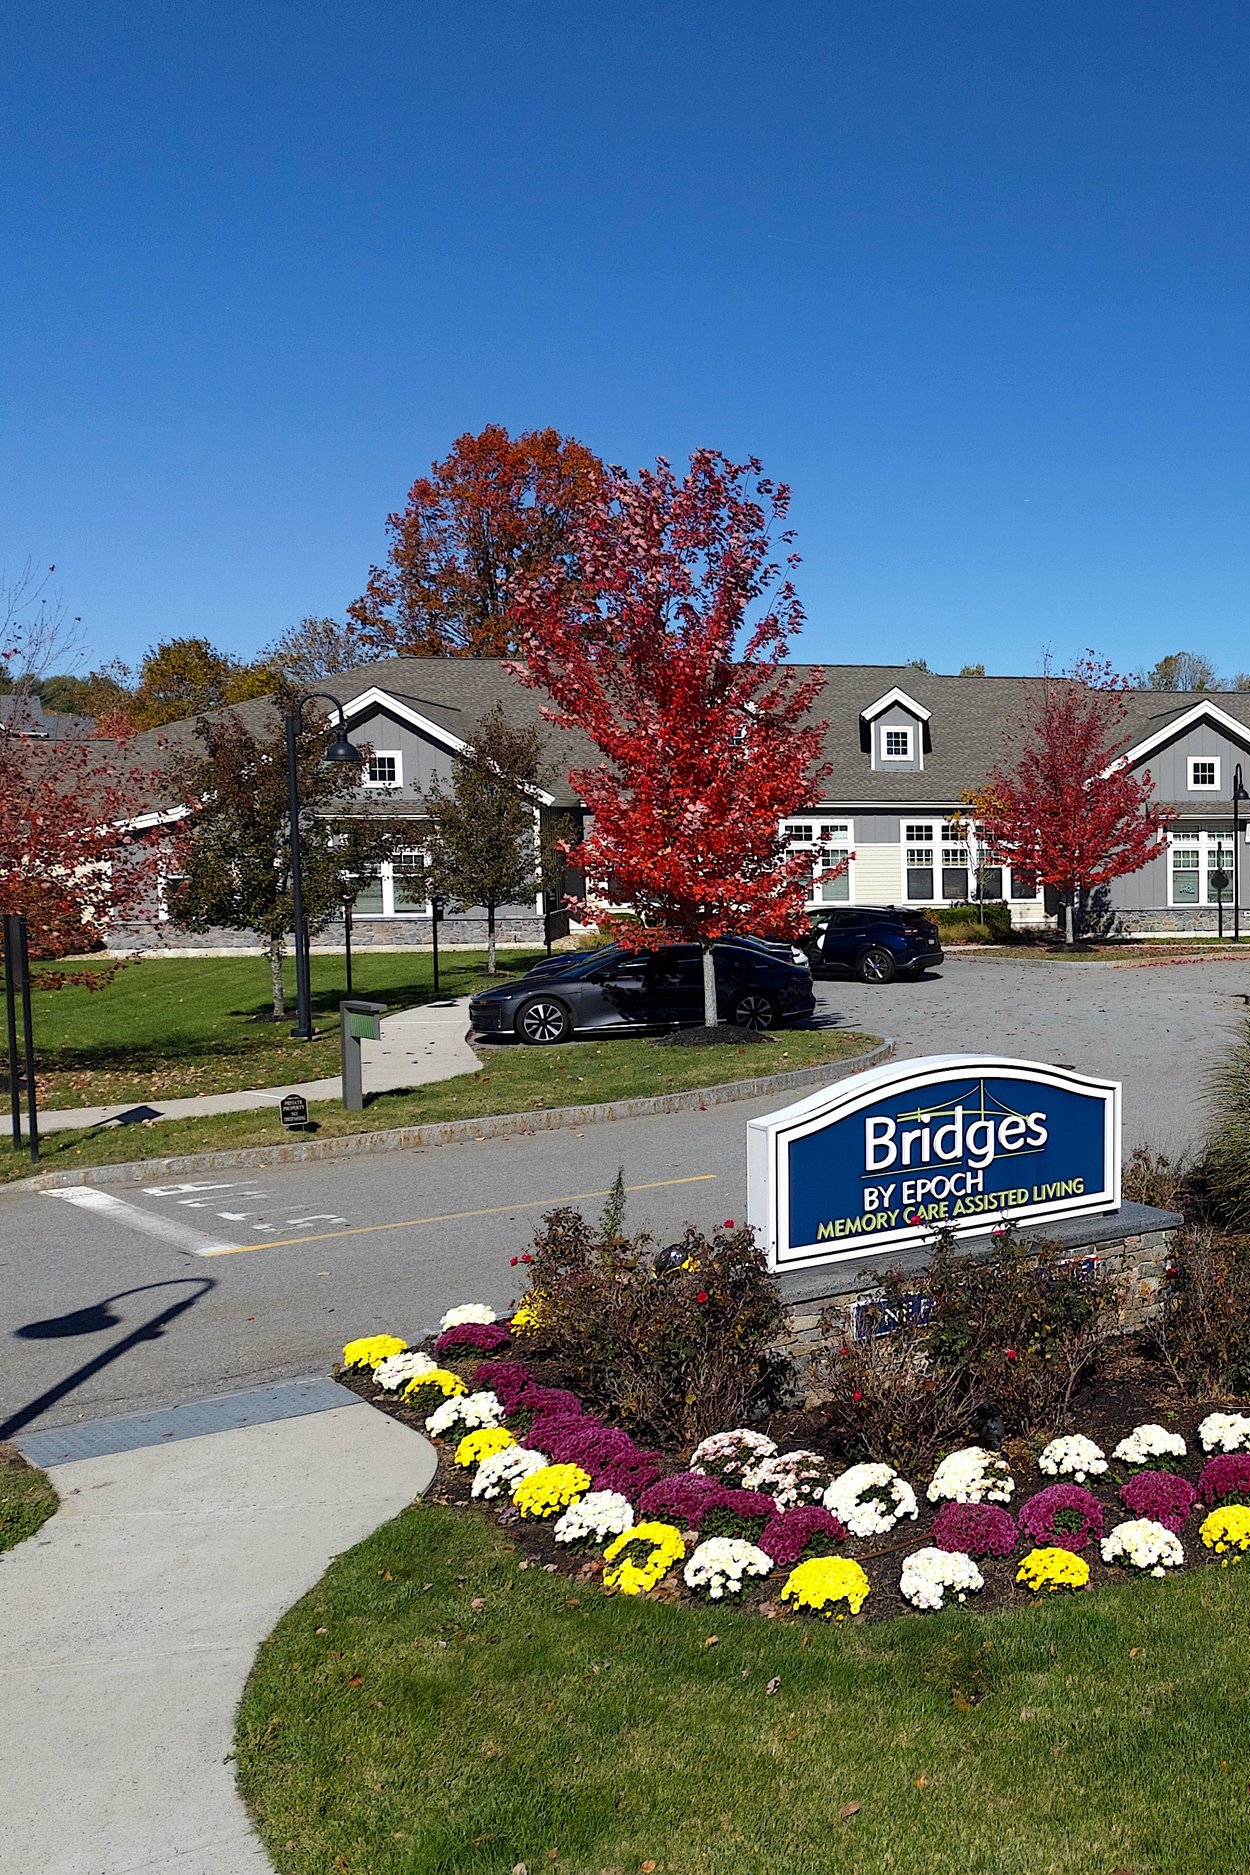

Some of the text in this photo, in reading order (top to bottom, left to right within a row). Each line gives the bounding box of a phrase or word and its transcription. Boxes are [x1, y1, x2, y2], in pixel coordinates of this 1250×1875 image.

[865, 1105, 1048, 1171] Bridges
[816, 1177, 1084, 1240] MEMORY CARE ASSISTED LIVING
[864, 1169, 983, 1211] BY EPOCH
